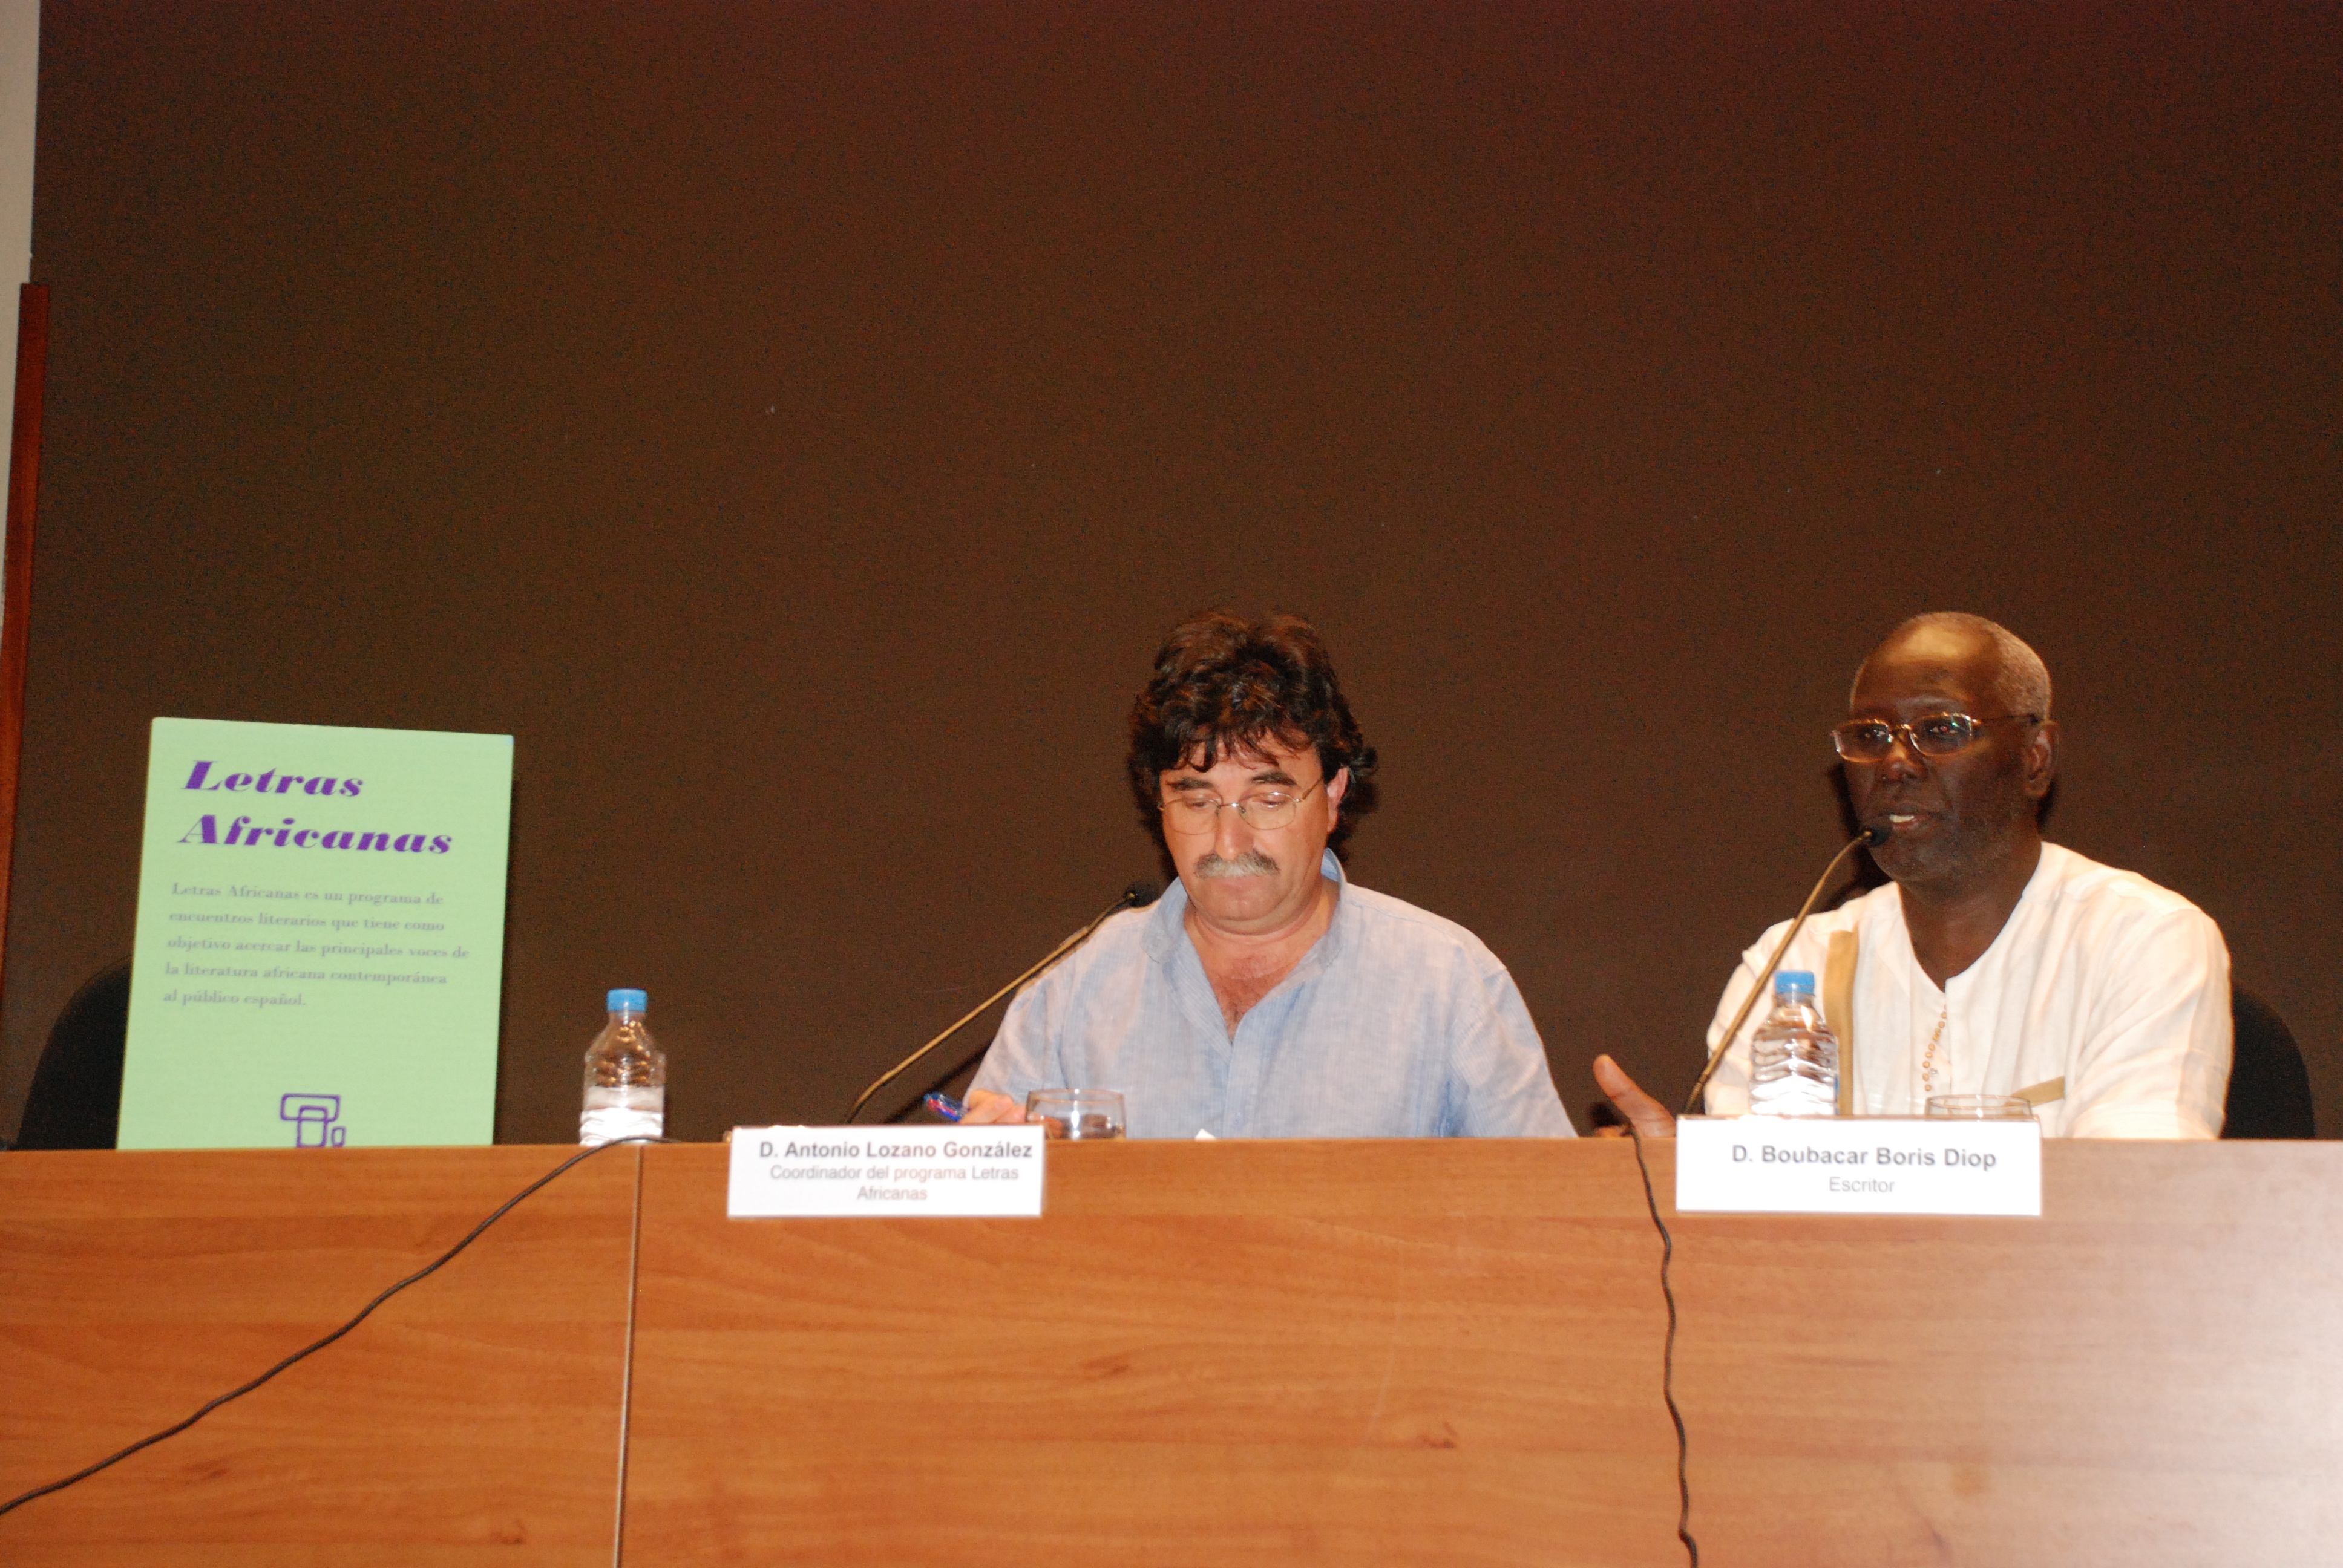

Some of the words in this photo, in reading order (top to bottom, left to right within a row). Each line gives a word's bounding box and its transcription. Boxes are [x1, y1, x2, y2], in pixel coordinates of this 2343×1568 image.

[181, 760, 363, 797] Letras
[177, 814, 453, 854] Africanas
[172, 882, 221, 896] Letras
[228, 885, 300, 899] Africanas
[348, 893, 421, 906] programa
[426, 892, 443, 904] de
[169, 913, 254, 924] encuentros
[258, 912, 327, 926] literarios
[331, 920, 358, 932] que
[364, 918, 400, 929] tiene
[404, 922, 445, 931] como
[167, 936, 231, 952] objetivo
[235, 942, 292, 952] acercar
[295, 940, 316, 953] las
[321, 942, 403, 959] principales
[408, 949, 448, 957] voces
[452, 946, 470, 958] de
[165, 962, 179, 975] la
[184, 962, 258, 978] literatura
[263, 966, 326, 979] africana
[330, 972, 447, 986] contemporánea
[163, 989, 177, 1002] al
[182, 990, 240, 1006] público
[243, 993, 306, 1008] español.
[759, 1141, 778, 1158] D.
[784, 1142, 860, 1158] Antonio
[867, 1142, 936, 1158] Lozano
[943, 1141, 1032, 1158] González
[1732, 1145, 1753, 1162] D.
[1762, 1145, 1868, 1165] Boubacar
[1876, 1147, 1935, 1166] Boris
[1944, 1148, 1996, 1171] Diop
[770, 1165, 862, 1180] Coordinador
[866, 1165, 889, 1180] del
[894, 1168, 967, 1183] programa
[972, 1166, 1019, 1180] Letras
[1829, 1176, 1895, 1193] Escritor
[857, 1186, 928, 1200] Africanas
